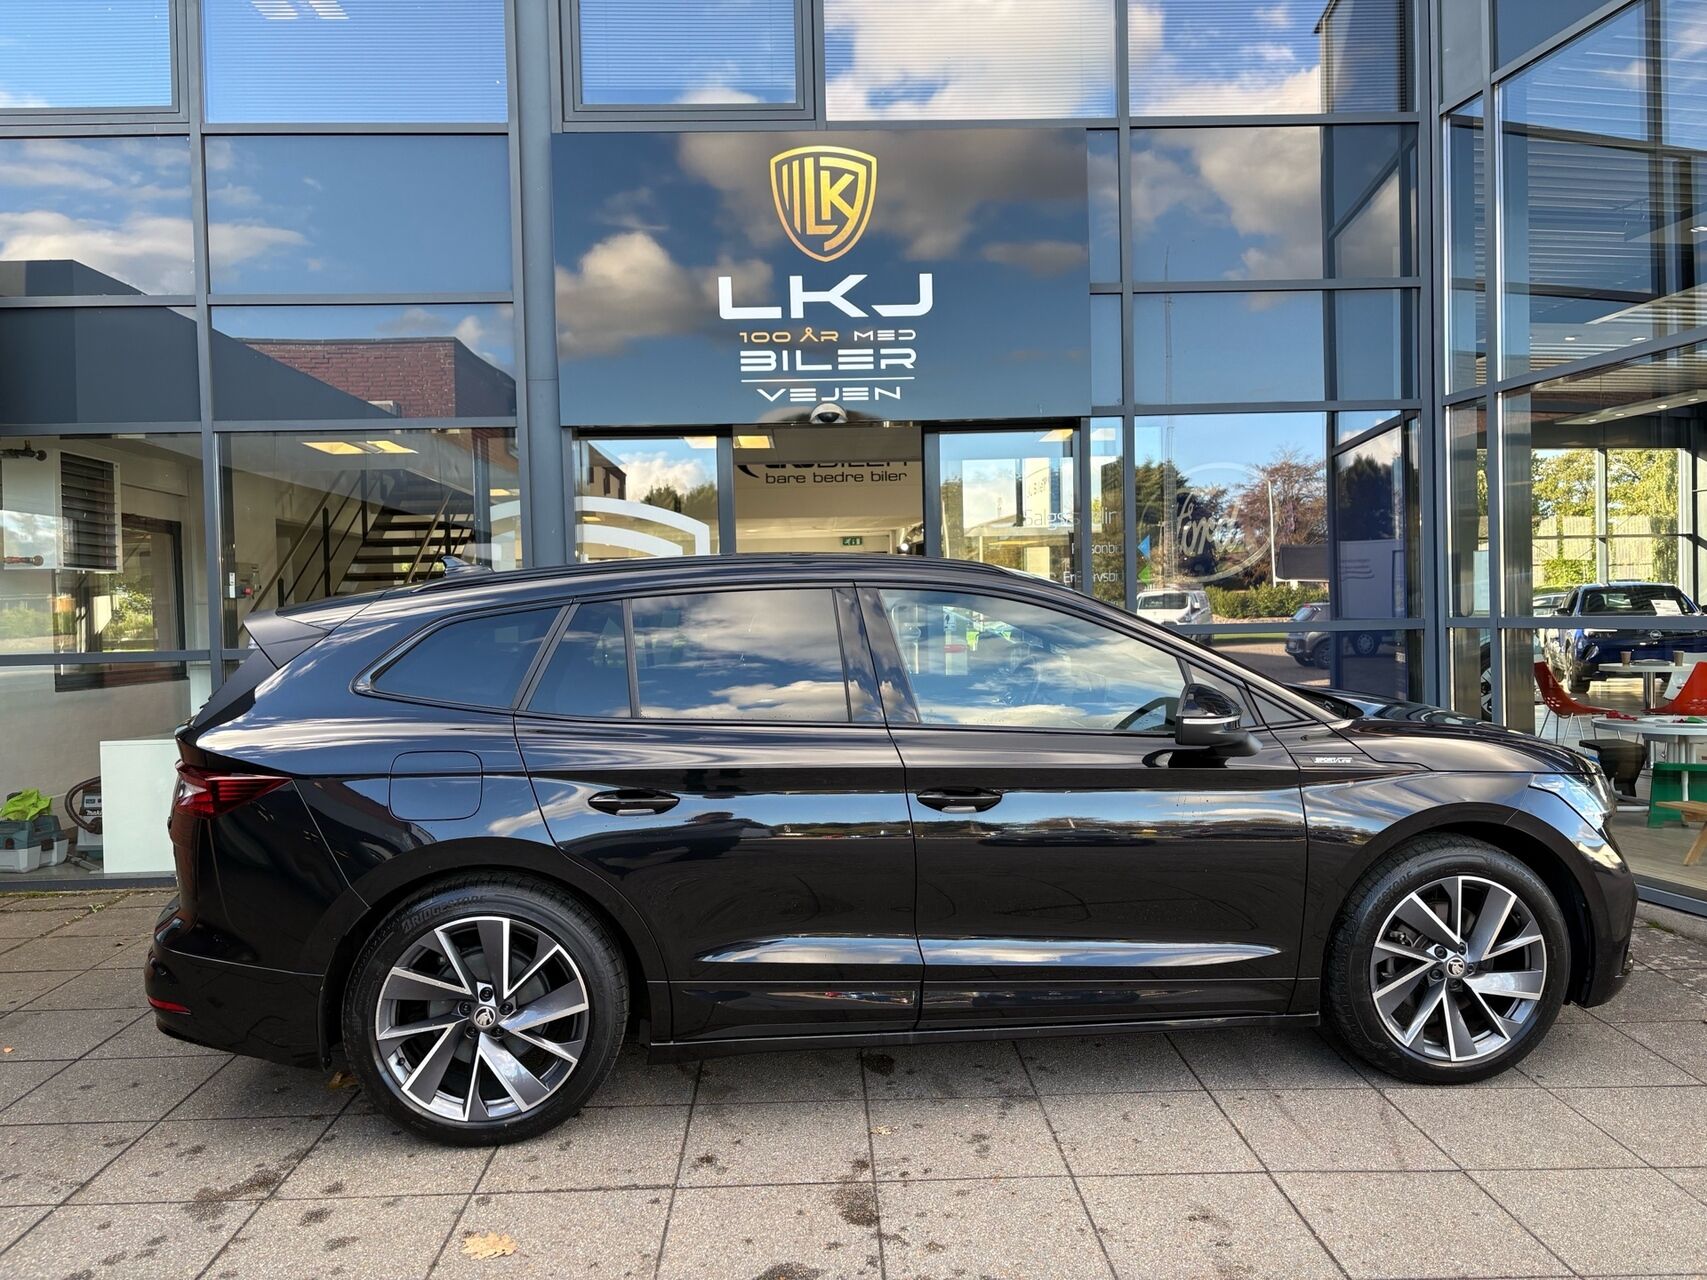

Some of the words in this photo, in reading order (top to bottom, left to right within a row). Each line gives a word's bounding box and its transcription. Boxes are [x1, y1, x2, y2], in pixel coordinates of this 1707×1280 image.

[718, 273, 934, 320] LKJ
[739, 331, 792, 343] 100
[800, 327, 840, 342] ÅR
[854, 329, 917, 341] MED
[740, 348, 917, 372] BILER
[756, 386, 901, 402] VEJEN
[765, 473, 806, 484] bare
[813, 472, 864, 483] bedre
[871, 471, 907, 482] biler
